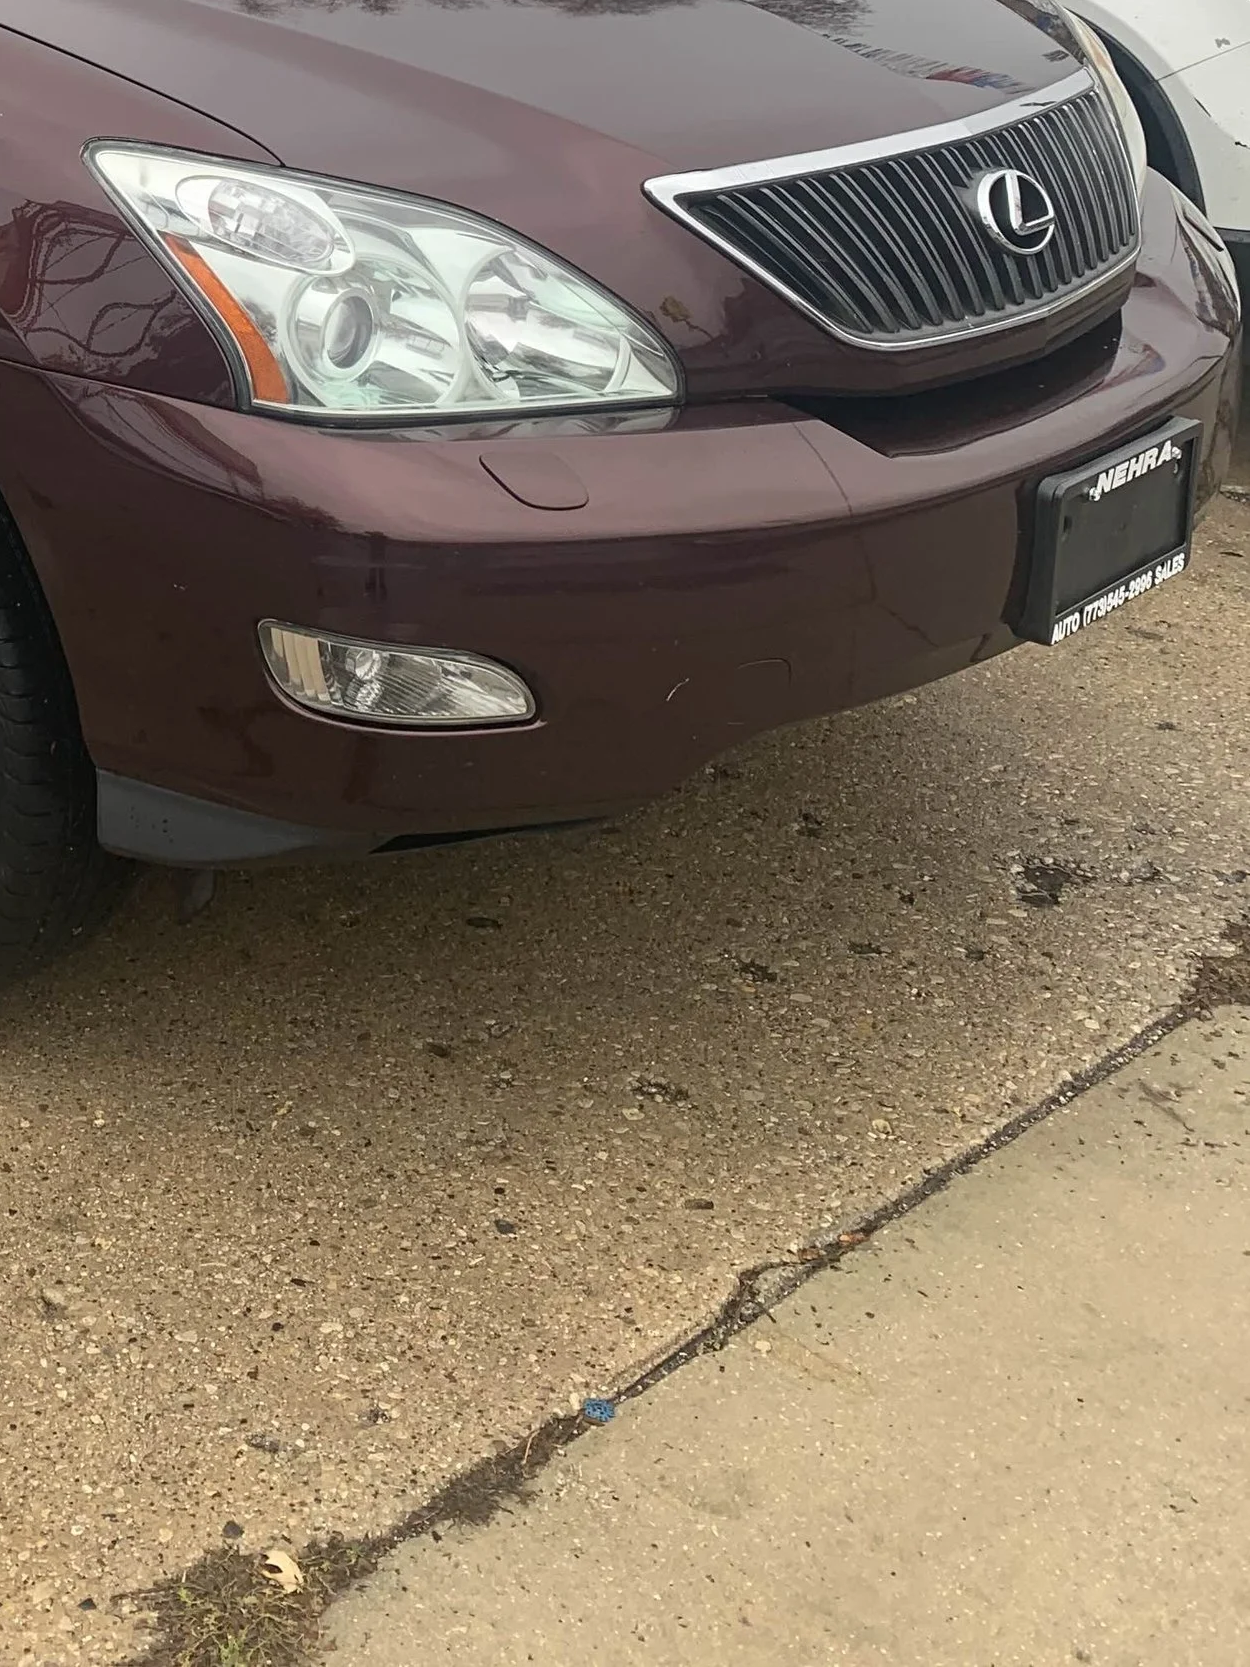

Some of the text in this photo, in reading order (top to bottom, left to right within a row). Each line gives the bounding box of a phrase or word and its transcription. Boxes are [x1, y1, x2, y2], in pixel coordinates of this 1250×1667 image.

[1097, 439, 1172, 494] NEHRA
[1050, 611, 1080, 645] AUTO
[1154, 552, 1186, 585] SALES
